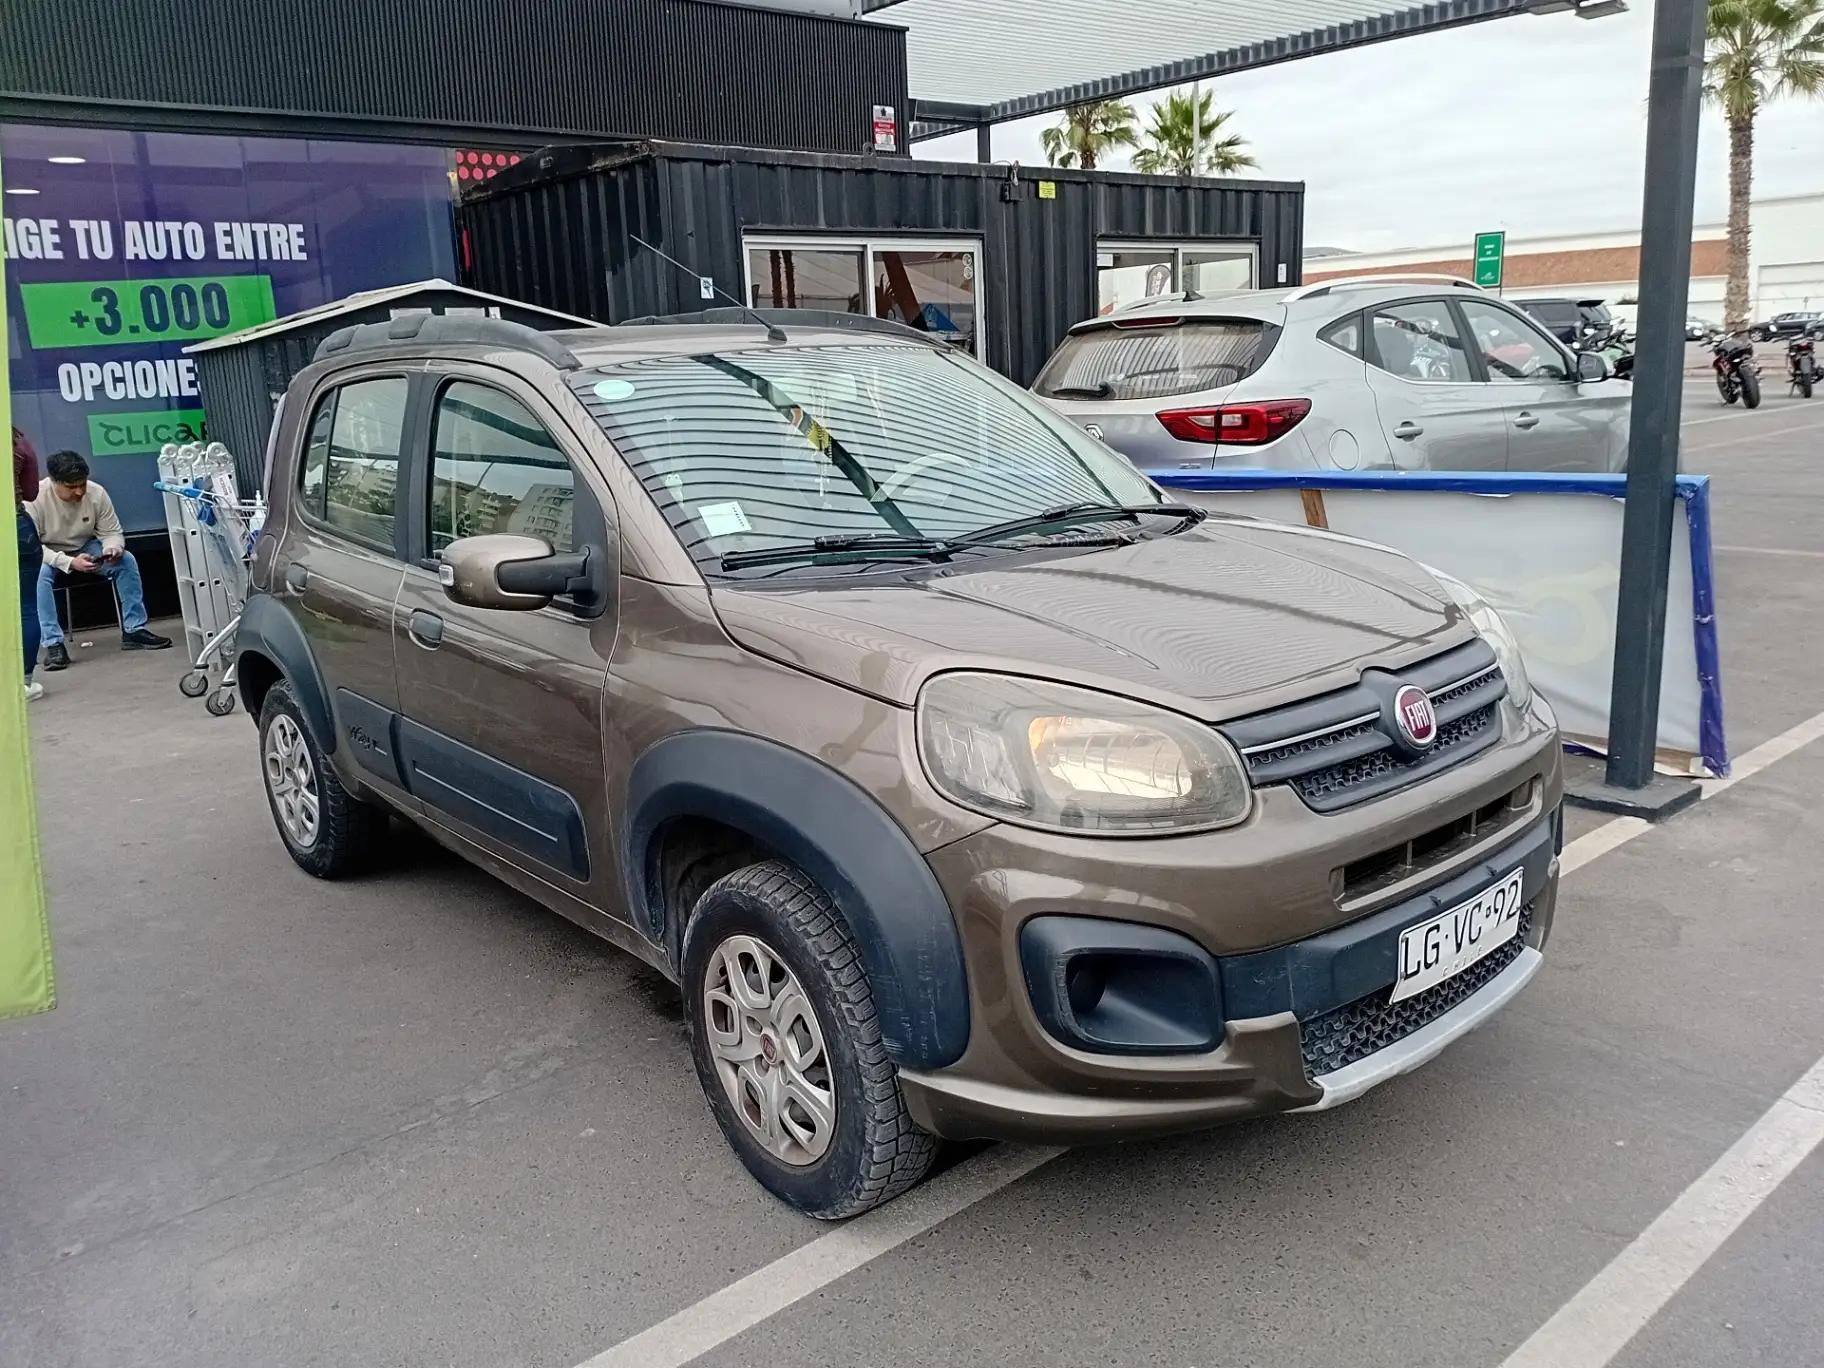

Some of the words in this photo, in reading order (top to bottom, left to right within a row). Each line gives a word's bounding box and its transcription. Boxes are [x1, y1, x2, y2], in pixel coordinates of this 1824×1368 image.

[4, 218, 64, 259] IGE
[69, 220, 114, 260] TU
[124, 221, 206, 260] AUTO
[214, 222, 308, 261] ENTRE
[70, 282, 231, 336] +3.000
[58, 358, 201, 402] OPCIONE
[1404, 700, 1430, 732] FIAT
